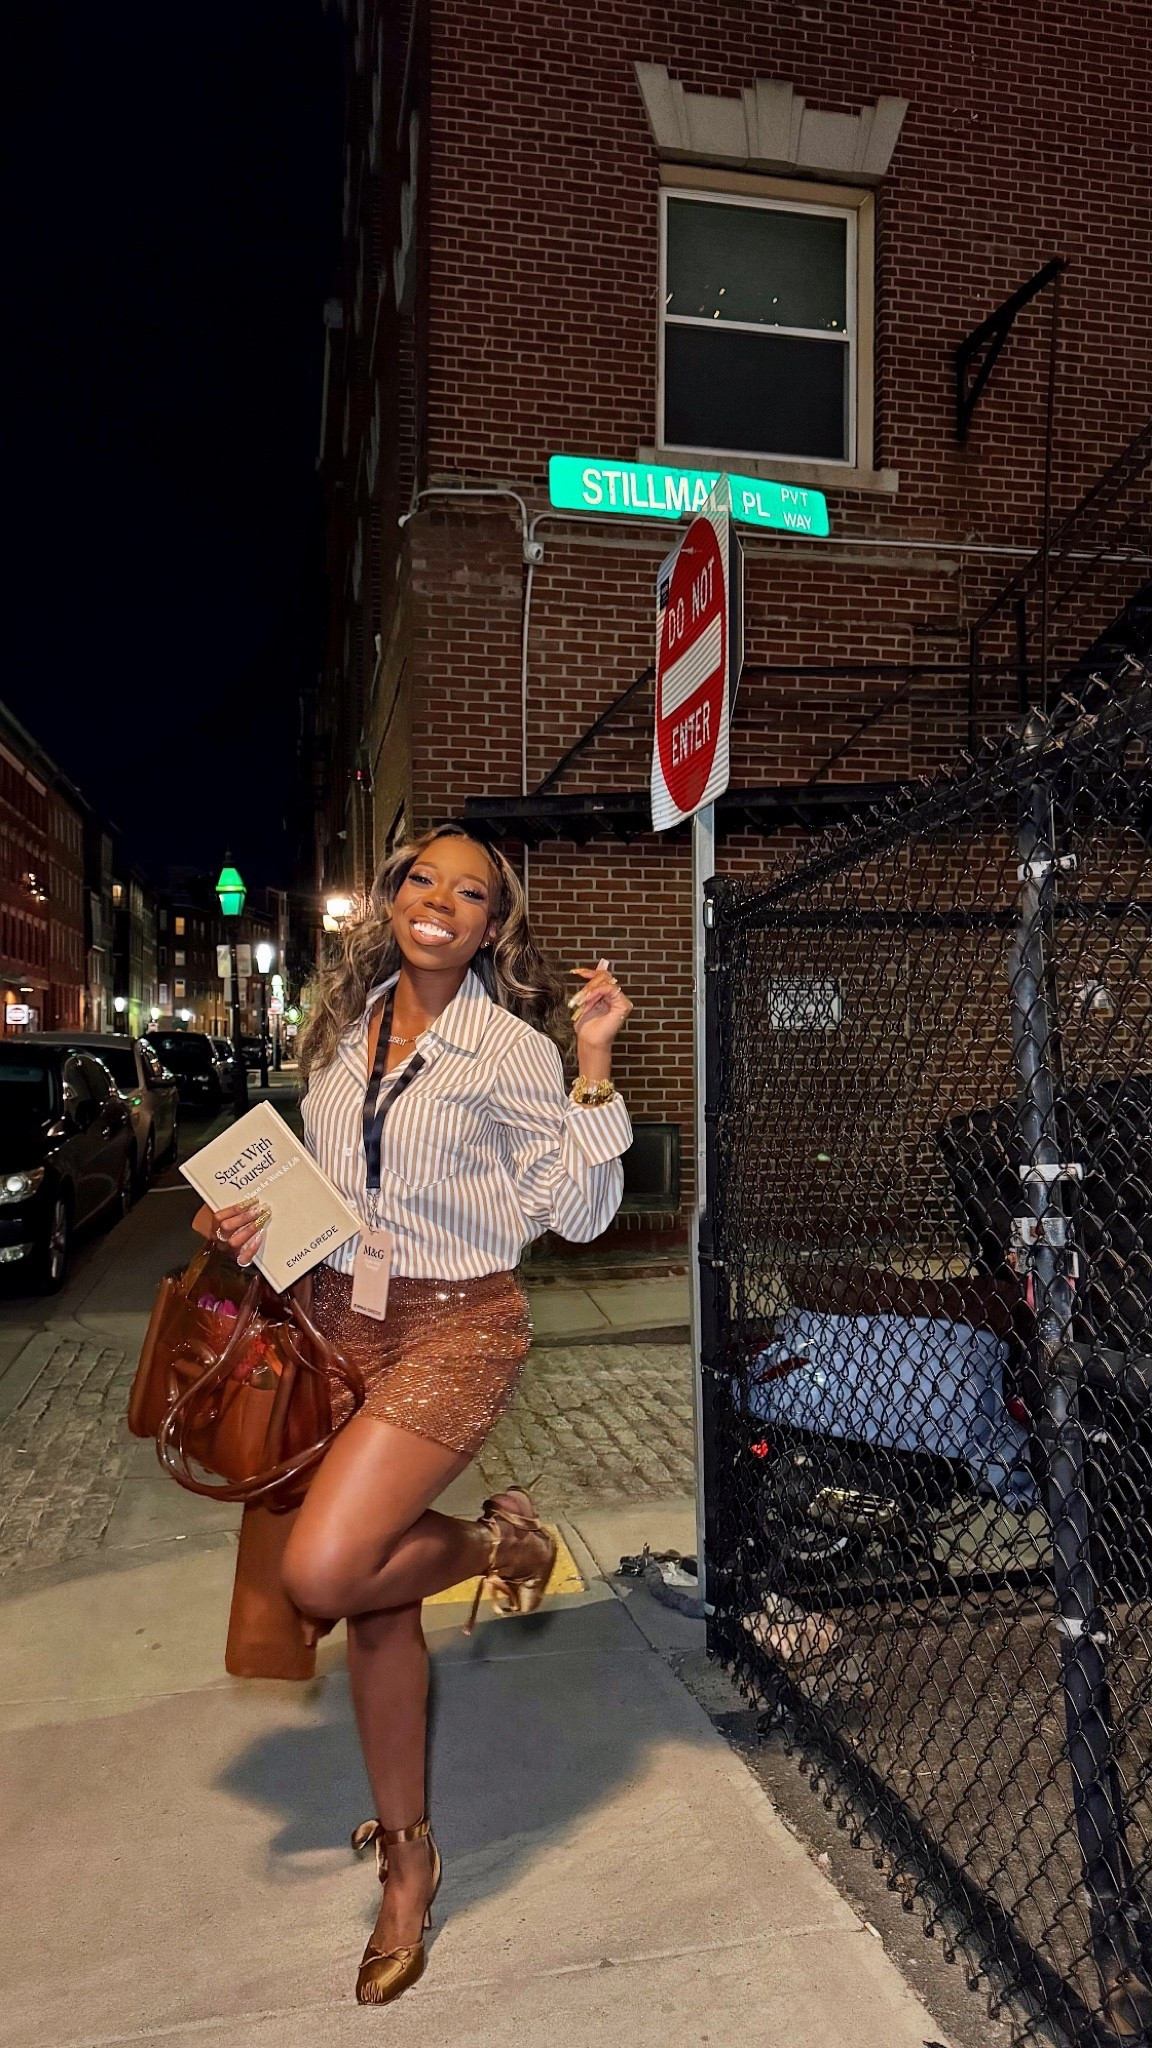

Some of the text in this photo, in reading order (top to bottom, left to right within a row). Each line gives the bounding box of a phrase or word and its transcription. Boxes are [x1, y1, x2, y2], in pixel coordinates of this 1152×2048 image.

[742, 490, 770, 517] PL
[781, 487, 808, 507] PVT
[783, 511, 812, 530] WAY
[668, 556, 715, 650] DO NOT
[672, 700, 711, 768] ENTER
[214, 1138, 273, 1185] Start With
[229, 1150, 276, 1190] Yourself
[286, 1225, 339, 1268] EMMA GREDE
[363, 1244, 385, 1260] M&G
